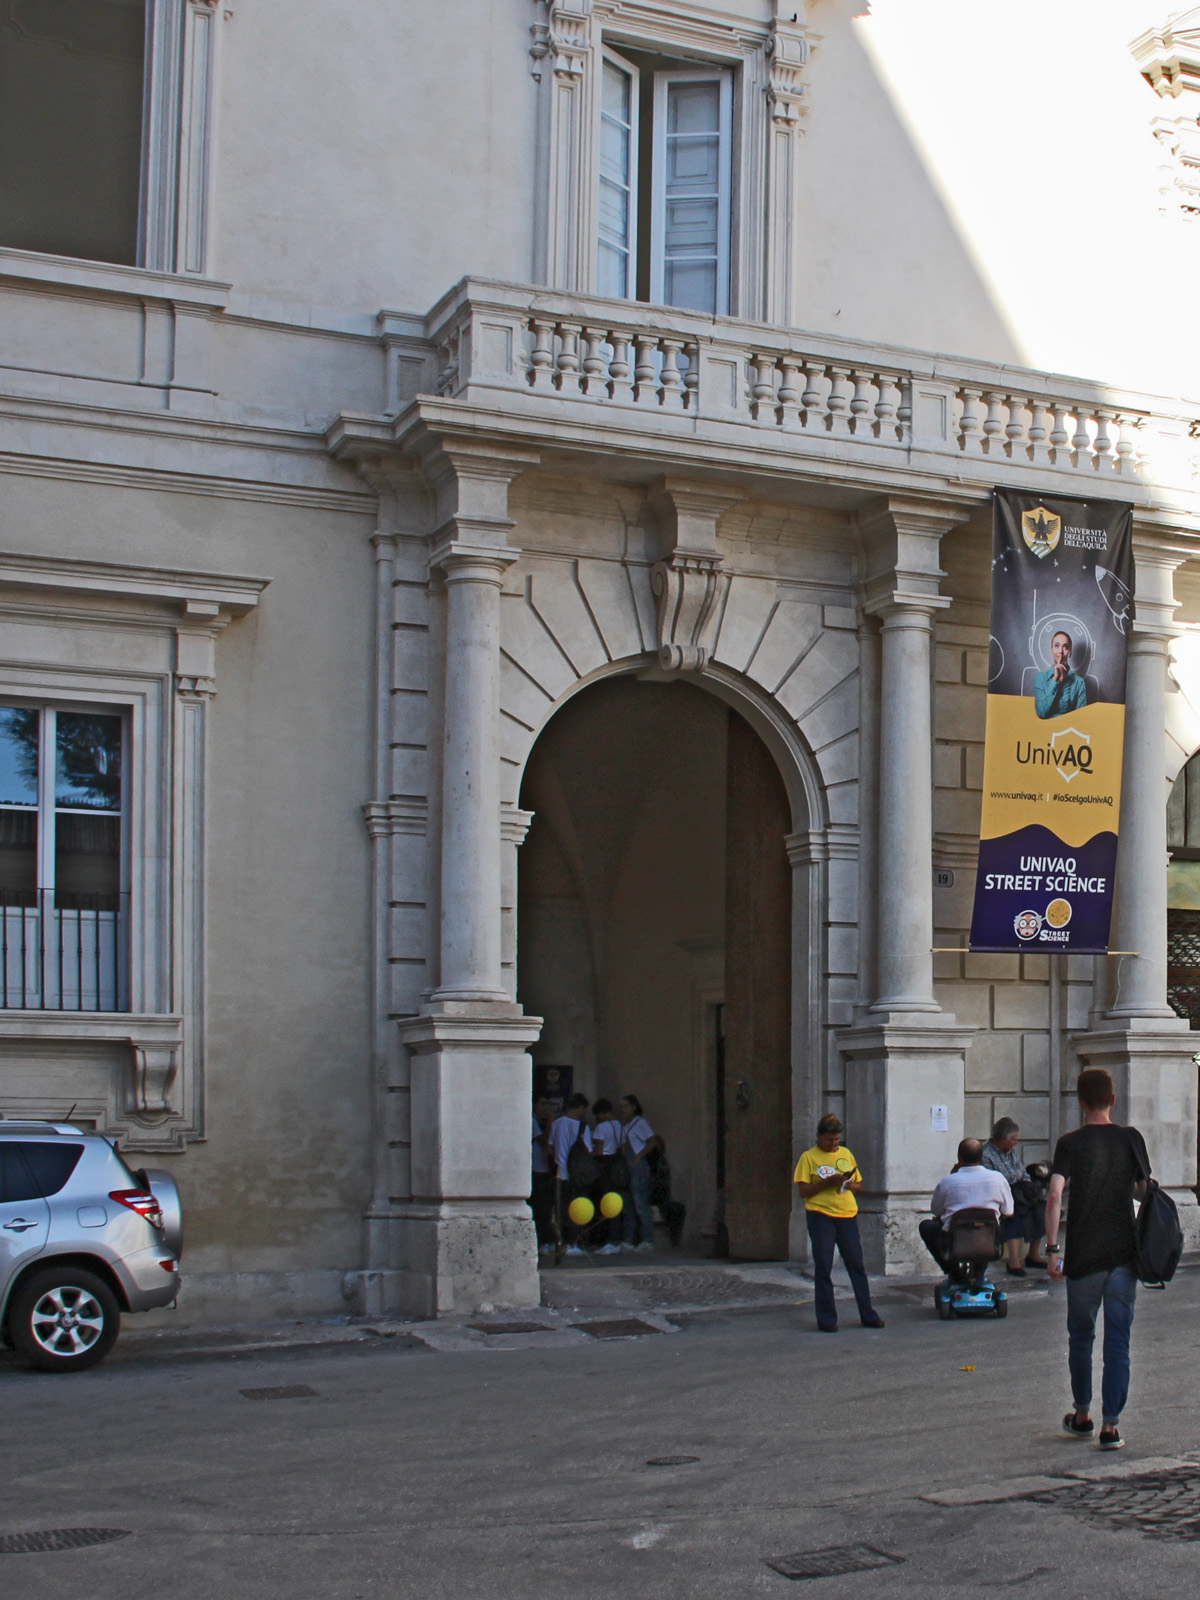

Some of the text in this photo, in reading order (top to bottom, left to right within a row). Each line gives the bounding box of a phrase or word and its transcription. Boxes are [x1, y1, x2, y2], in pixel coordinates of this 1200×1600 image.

[1064, 526, 1107, 537] UNIVERSITÀ
[1064, 533, 1085, 542] DEGLI
[1064, 540, 1107, 550] DELL'AQUILA
[1016, 741, 1093, 774] UnivAQ
[990, 791, 1113, 806] www.univaq.it #ioScelgoUnivAQ
[1020, 856, 1076, 876] UNIVAQ
[938, 873, 949, 884] 19
[985, 874, 1106, 893] STREET SCIENCE
